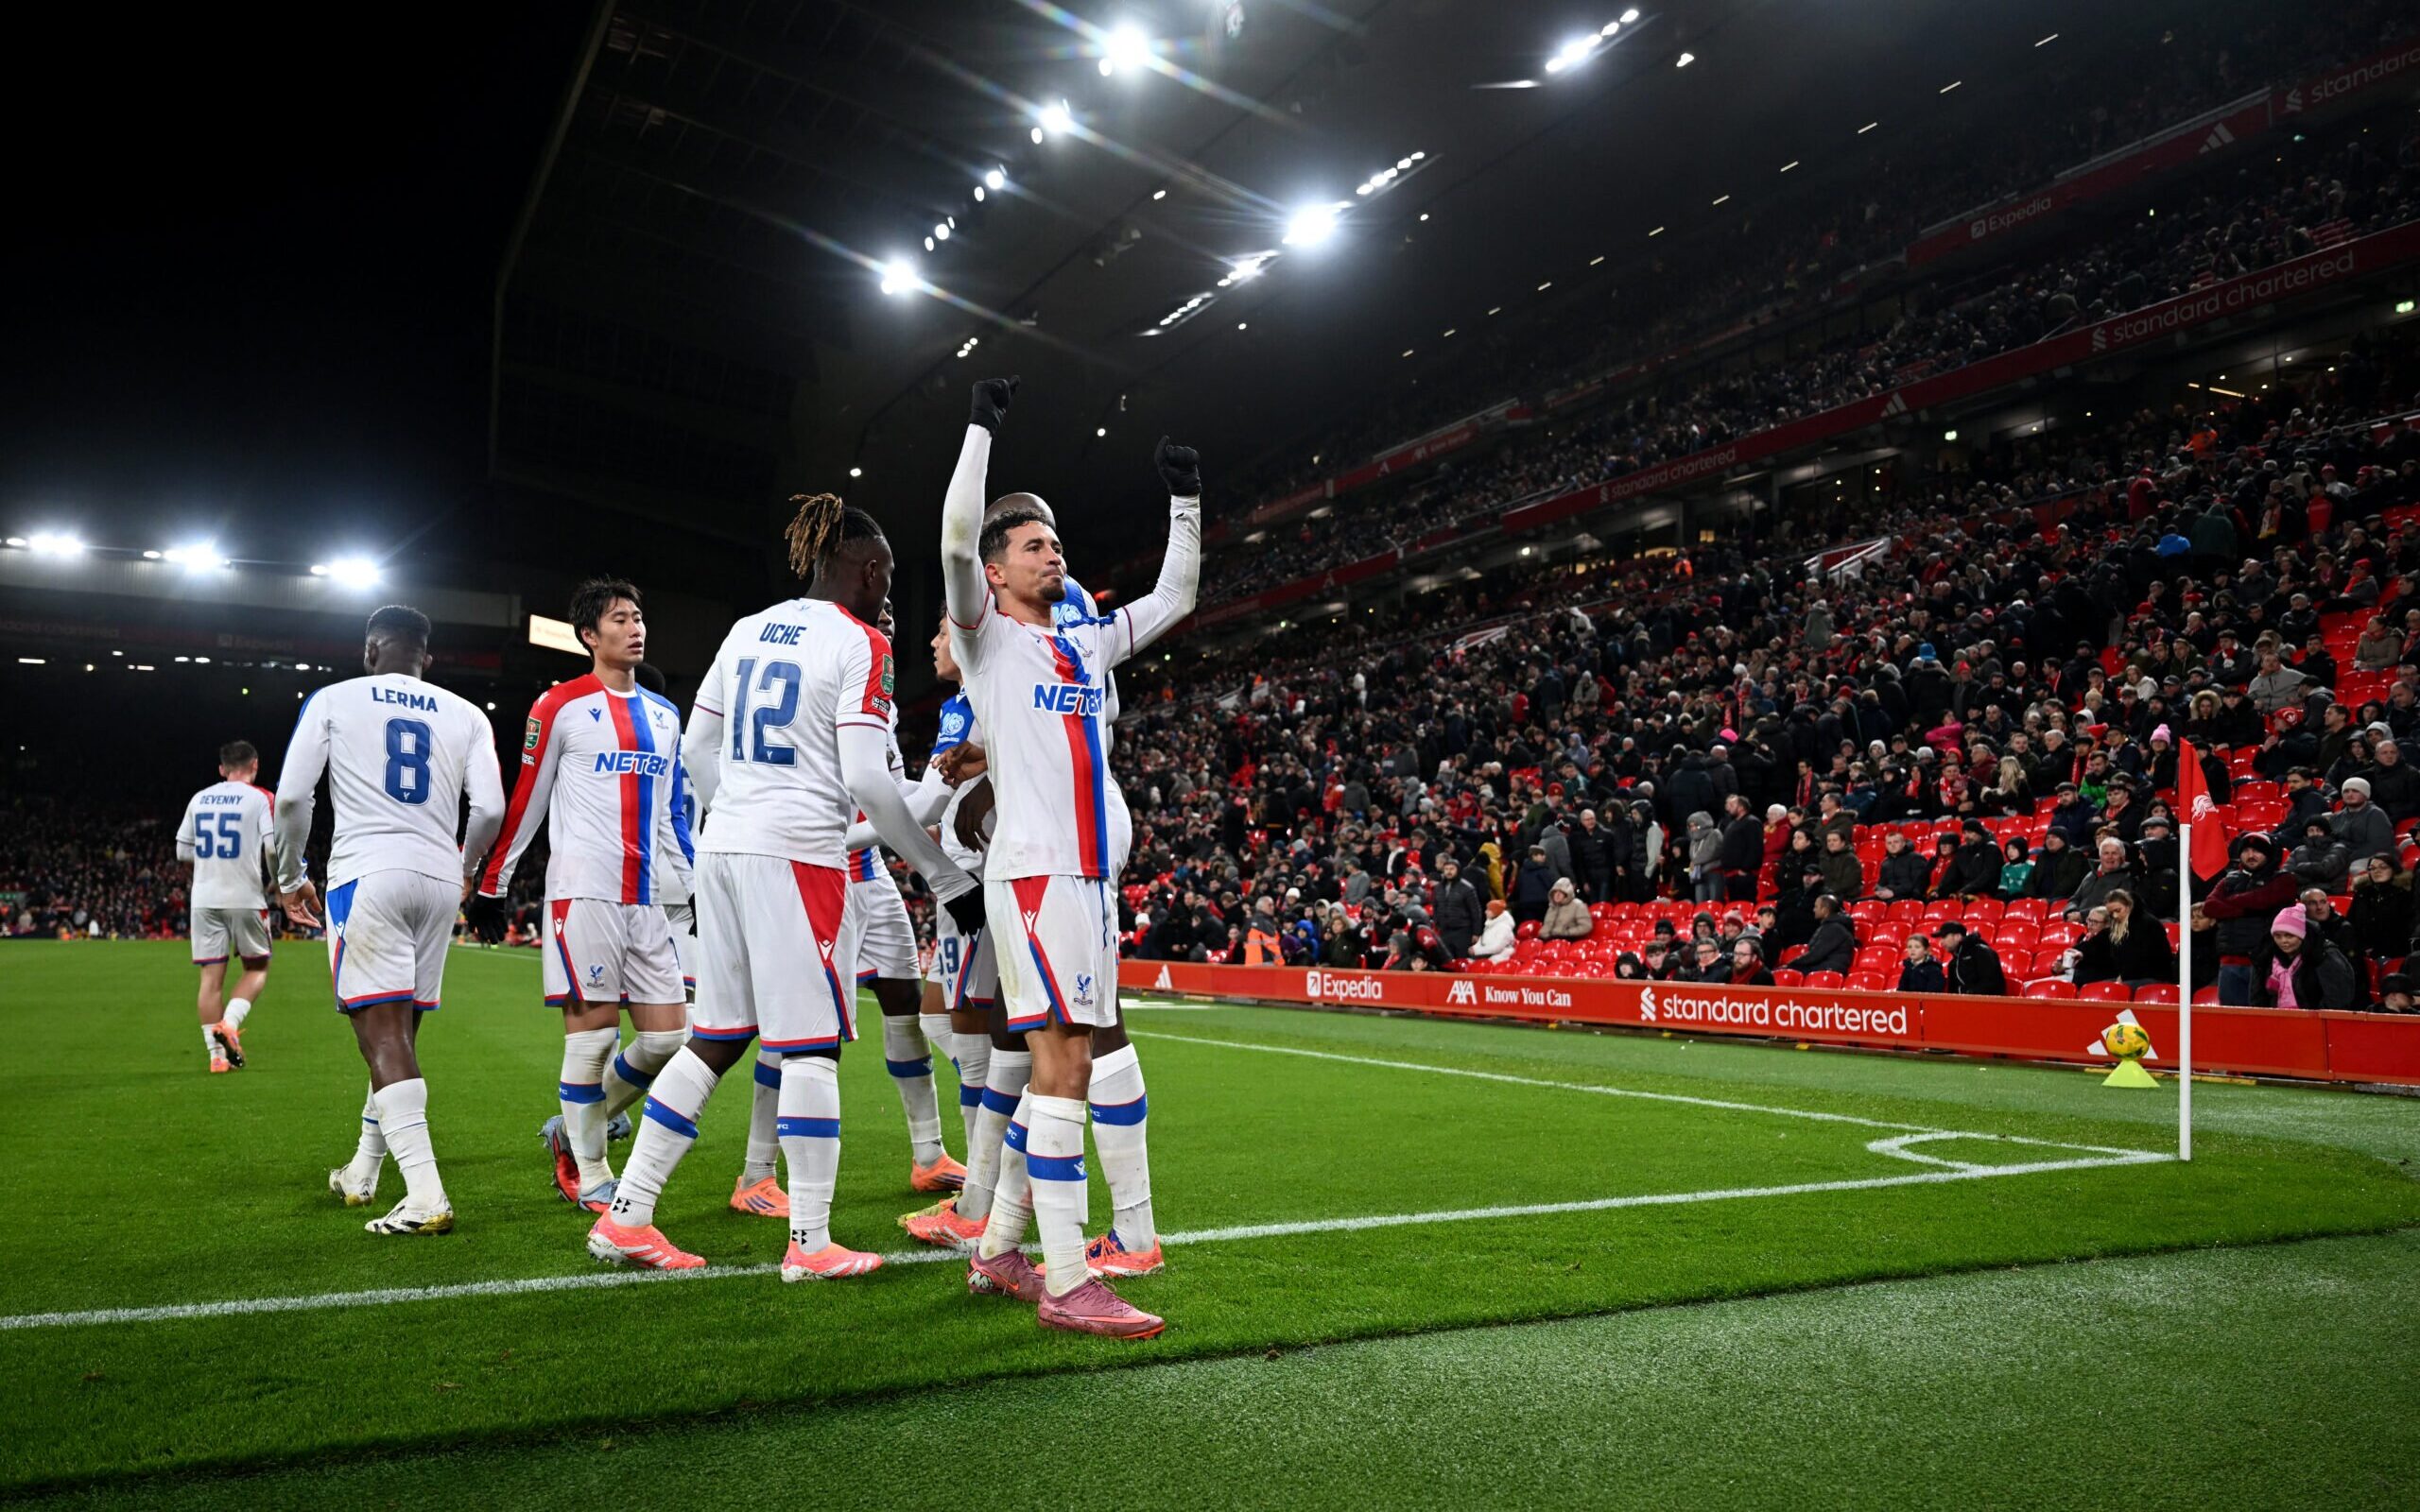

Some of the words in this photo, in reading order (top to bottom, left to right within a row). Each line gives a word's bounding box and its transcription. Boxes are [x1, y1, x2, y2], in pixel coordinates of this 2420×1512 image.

[1988, 197, 2051, 232] Expedia
[2113, 292, 2221, 343] standard
[2224, 249, 2355, 307] chartered
[1612, 468, 1669, 499] standard
[1670, 446, 1737, 480] chartered
[759, 622, 806, 645] UCHE
[372, 686, 439, 713] LERMA
[731, 656, 804, 768] 12
[383, 716, 433, 807] 8
[199, 795, 243, 805] DEVENNY
[195, 812, 242, 860] 55
[1323, 974, 1383, 1001] Expedia
[1446, 980, 1478, 1005] AXA
[1485, 987, 1518, 1004] Know
[1521, 988, 1545, 1005] You
[1547, 990, 1571, 1006] Can
[1663, 993, 1770, 1025] standard
[1774, 1000, 1908, 1035] chartered
